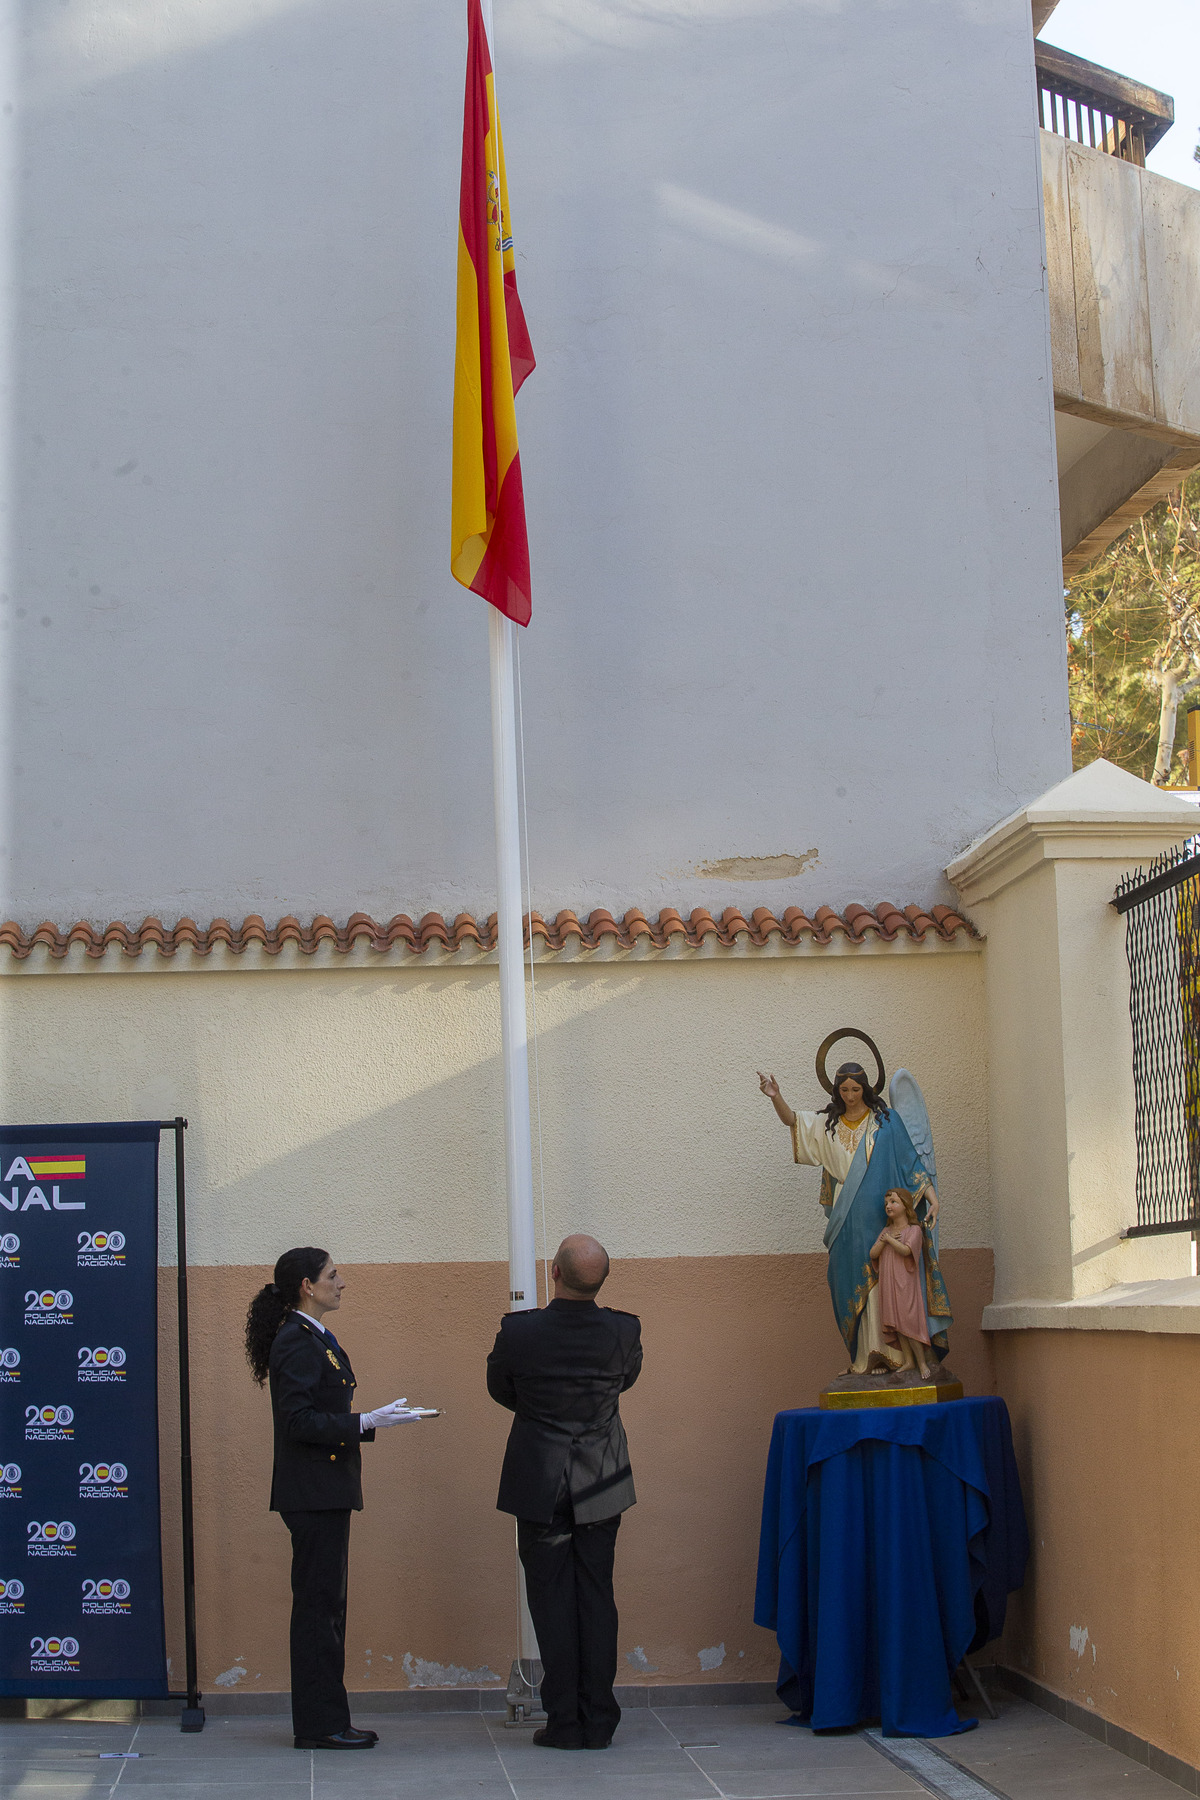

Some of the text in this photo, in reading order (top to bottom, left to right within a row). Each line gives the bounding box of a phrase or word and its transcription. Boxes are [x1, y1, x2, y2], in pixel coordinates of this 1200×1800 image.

[78, 1231, 125, 1252] 200
[25, 1290, 73, 1310] 200
[78, 1347, 126, 1367] 200
[25, 1405, 73, 1425] 200
[79, 1463, 127, 1483] 200
[27, 1522, 75, 1541] 200
[82, 1579, 130, 1599] 200
[31, 1637, 79, 1657] 200
